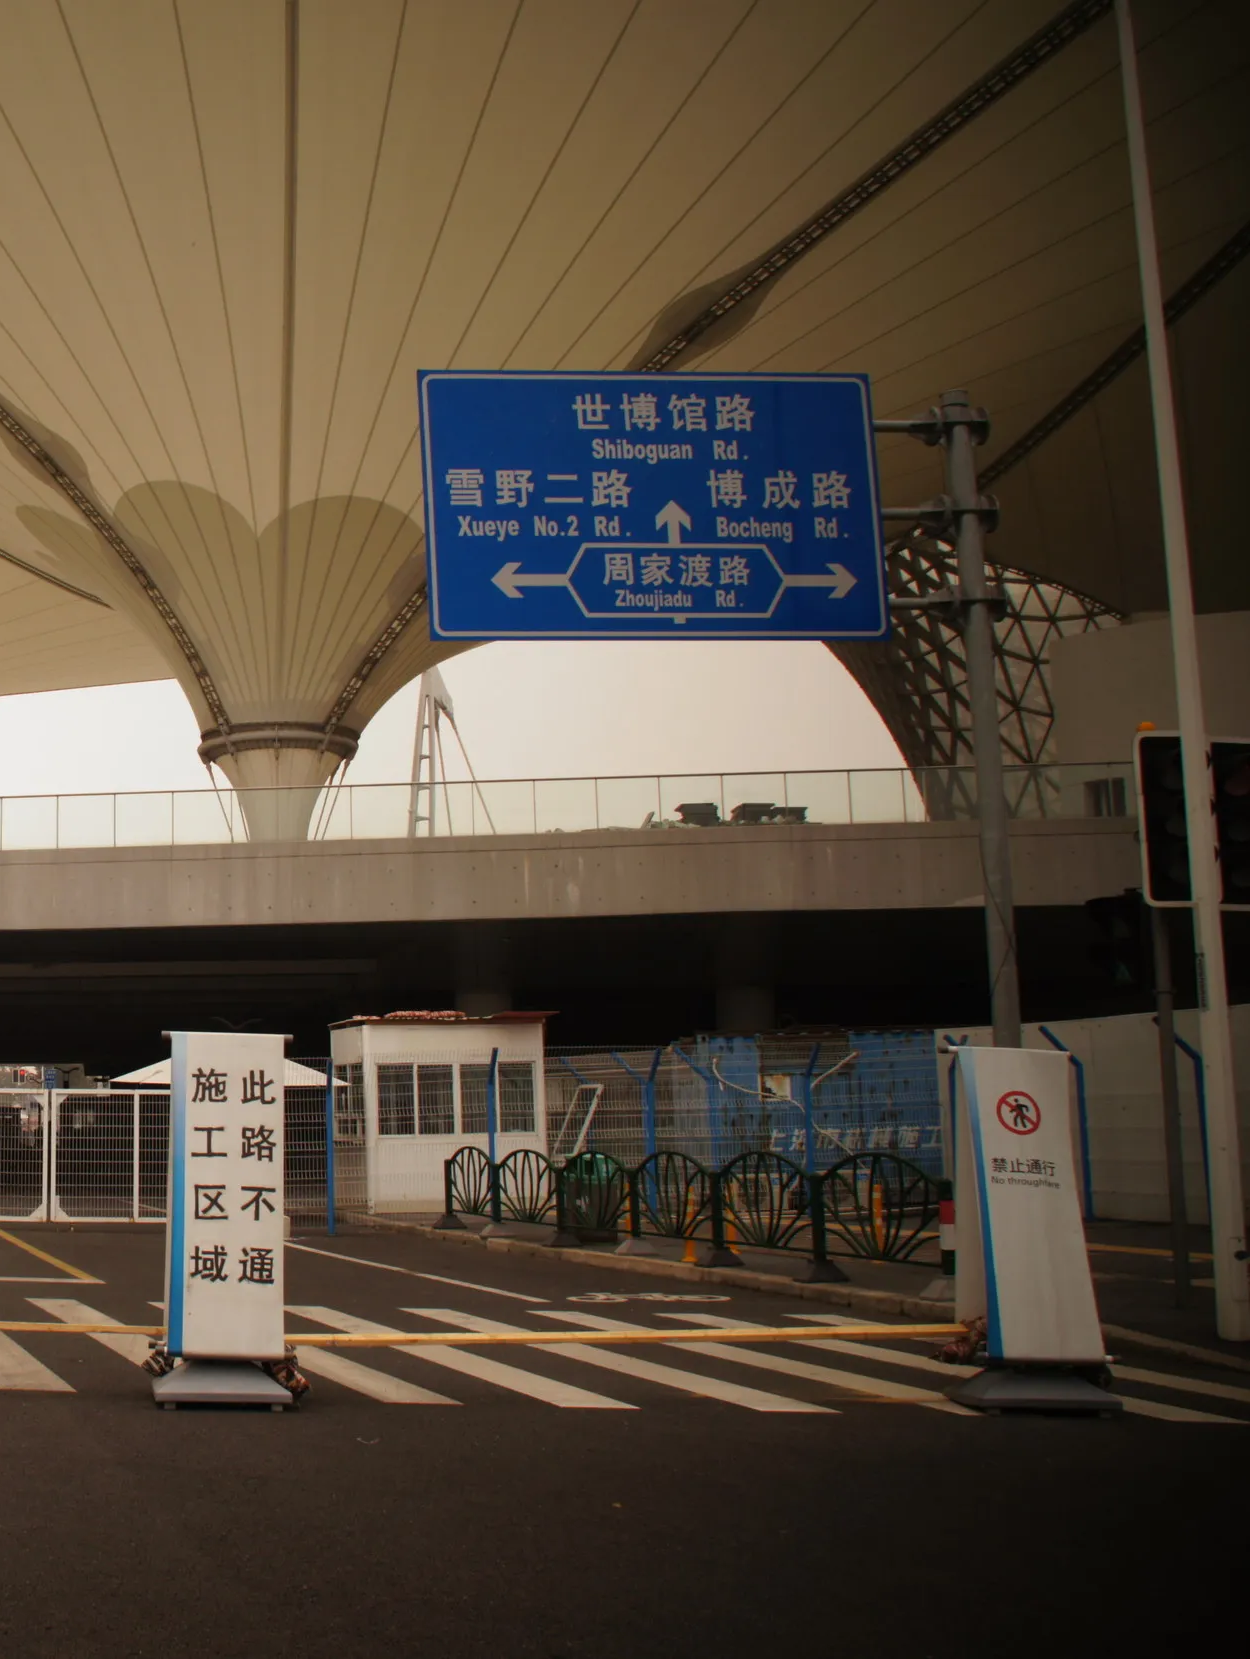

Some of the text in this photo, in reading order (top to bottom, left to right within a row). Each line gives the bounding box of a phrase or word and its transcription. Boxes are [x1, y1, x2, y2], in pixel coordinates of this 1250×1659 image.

[571, 392, 756, 432] 世博馆路
[591, 438, 749, 464] Shiboguan Rd.
[445, 468, 633, 509] 雪野二路
[706, 468, 852, 510] 博成路
[457, 515, 632, 542] Xueye No.2 Rd.
[716, 516, 850, 543] Bocheng Rd.
[603, 552, 751, 587] 周家渡路
[614, 589, 744, 611] Zhoujiadu Rd.
[190, 1068, 228, 1285] 施工区域
[238, 1070, 276, 1284] 此路不通
[991, 1158, 1056, 1176] 禁止通行
[991, 1176, 1005, 1185] No
